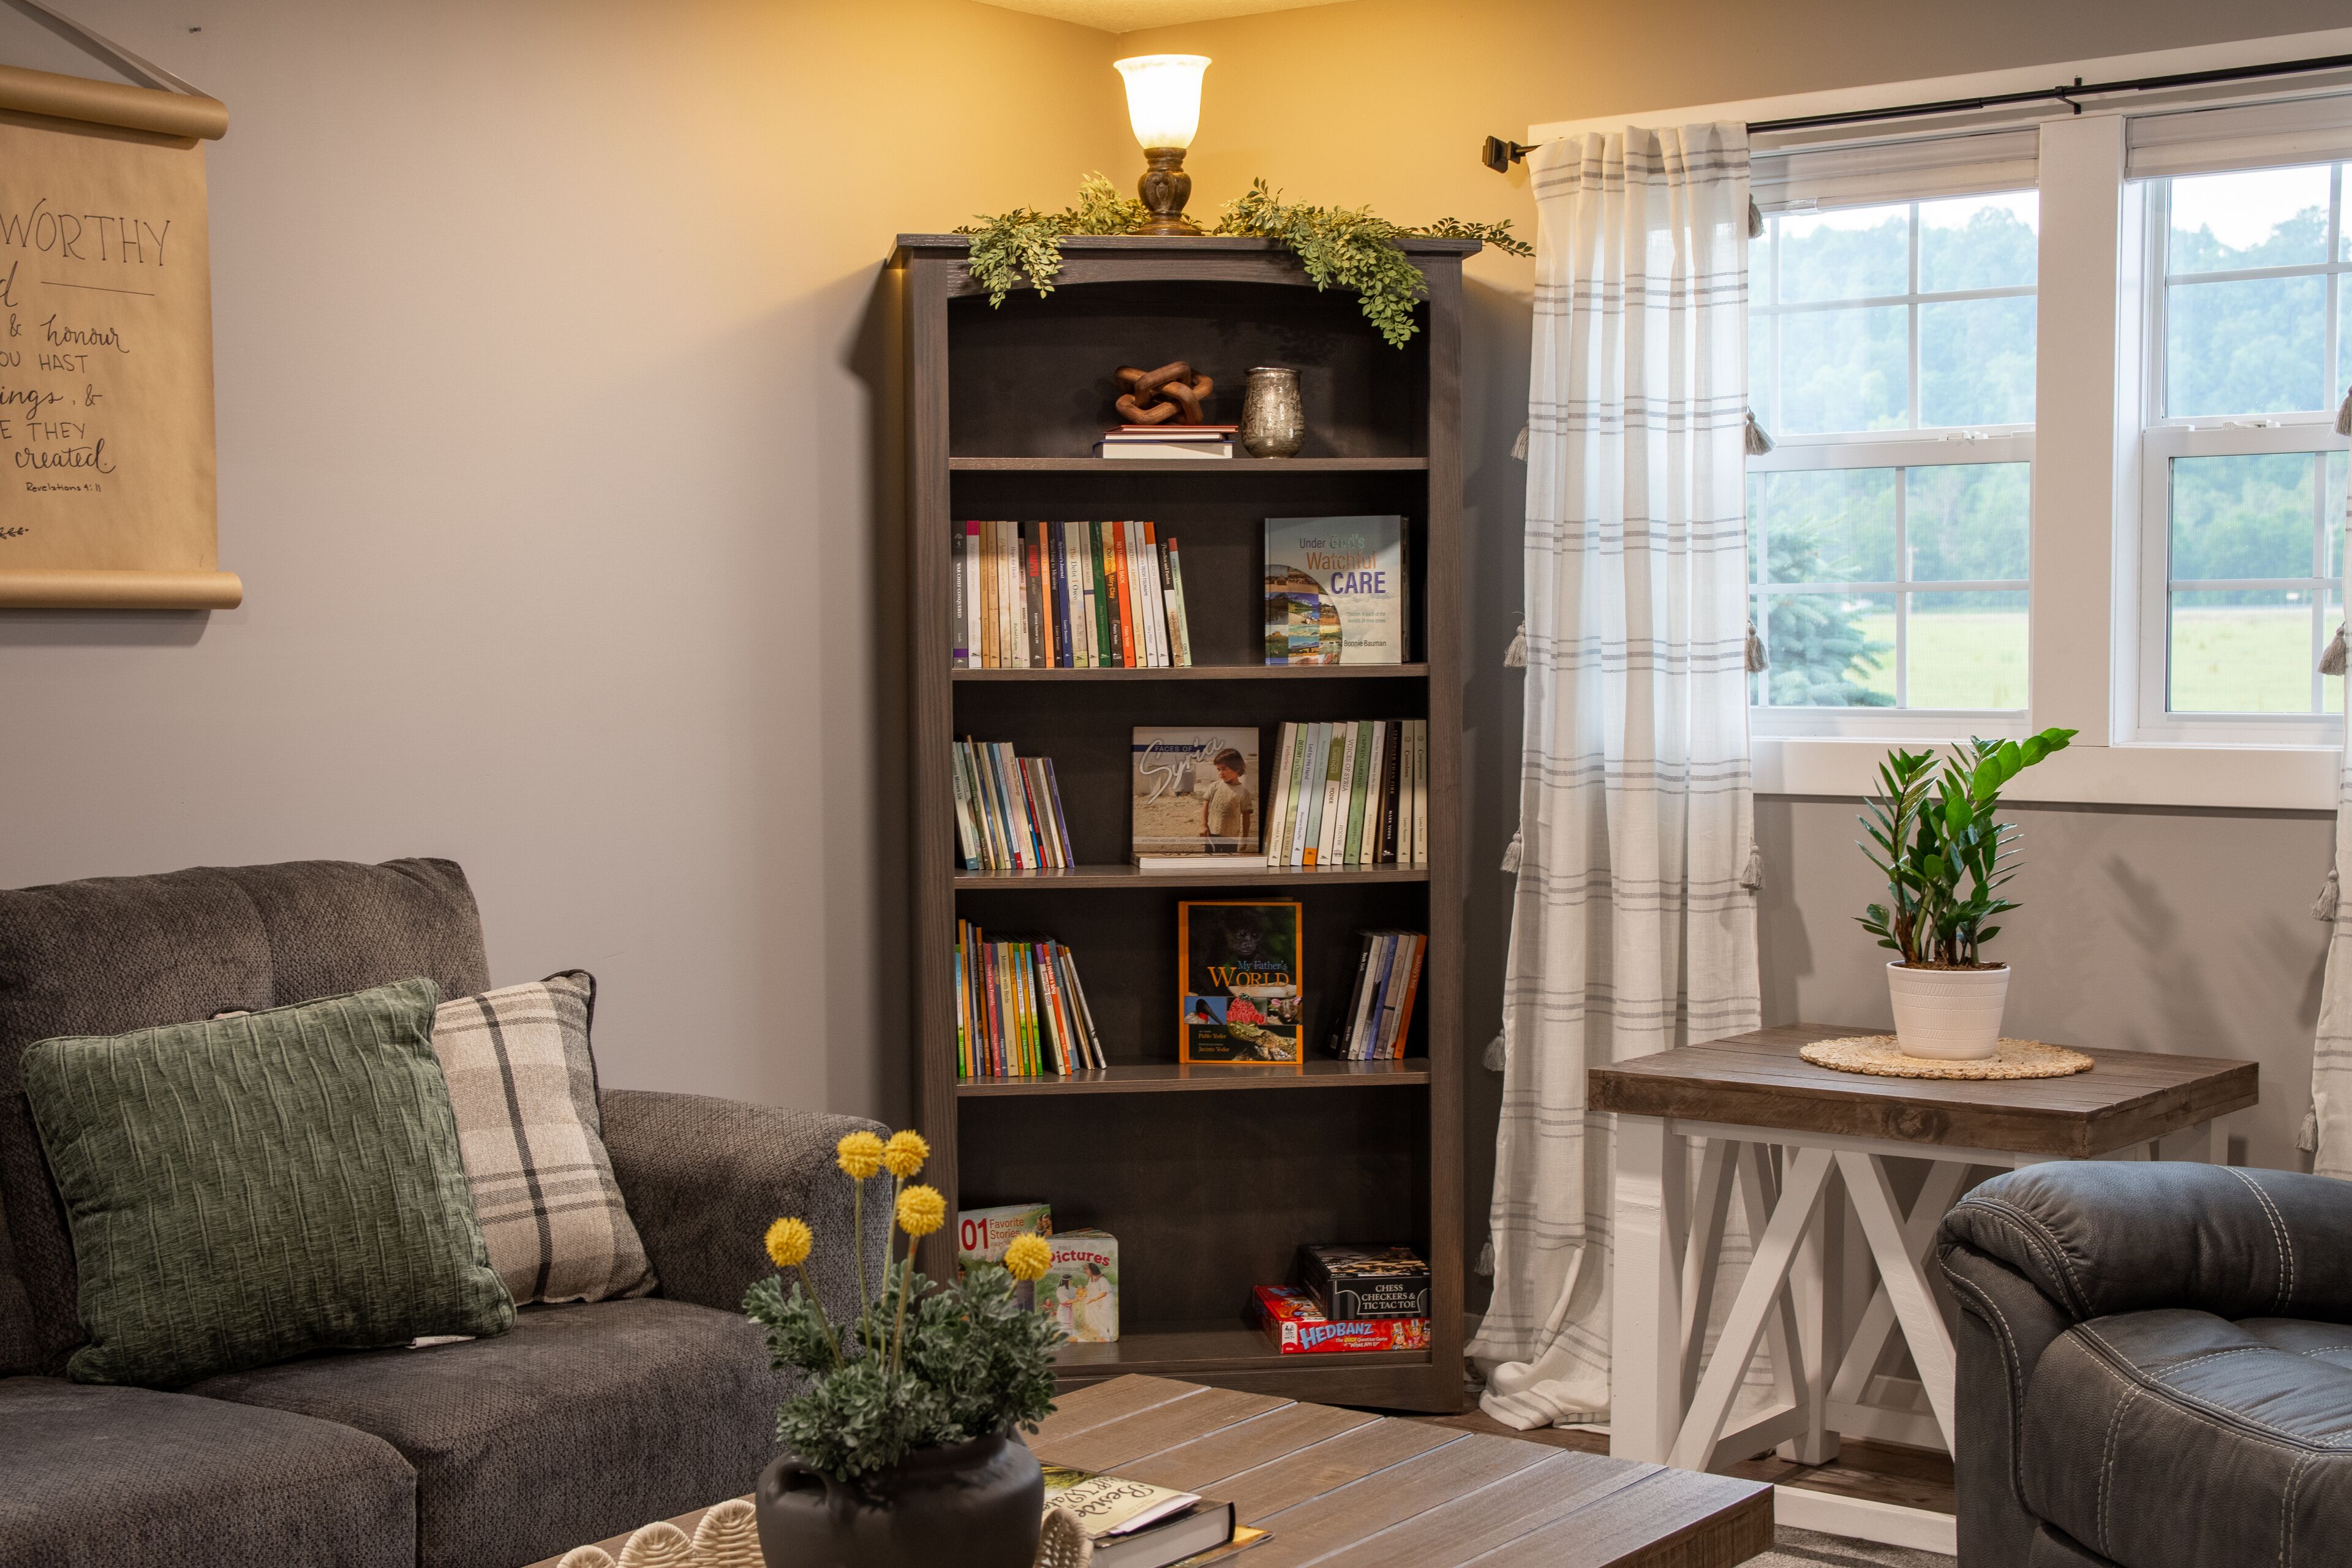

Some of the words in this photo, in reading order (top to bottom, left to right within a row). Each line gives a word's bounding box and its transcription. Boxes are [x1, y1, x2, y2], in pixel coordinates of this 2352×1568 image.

[0, 198, 170, 266] WORTHY
[9, 314, 23, 337] &
[40, 314, 130, 353] honour
[39, 353, 88, 373] HAST
[85, 383, 103, 407] &
[27, 421, 86, 441] THEY
[26, 481, 81, 492] Revelations
[83, 482, 102, 492] 4:11
[1117, 541, 1121, 551] NO
[1299, 538, 1326, 549] Under
[1306, 549, 1377, 570] Watchful
[1331, 571, 1386, 595] CARE
[1345, 739, 1354, 762] VOICES
[1139, 737, 1224, 805] Syria
[1345, 763, 1352, 772] OF
[1238, 960, 1251, 971] My
[1254, 960, 1288, 970] Father's
[1207, 967, 1289, 987] WORLD
[989, 1218, 1025, 1229] Favorite
[990, 1229, 1020, 1240] Stories
[1362, 1293, 1408, 1302] CHECKERS
[1299, 1322, 1374, 1351] HEDBANZ
[1074, 1483, 1154, 1518] Beside
